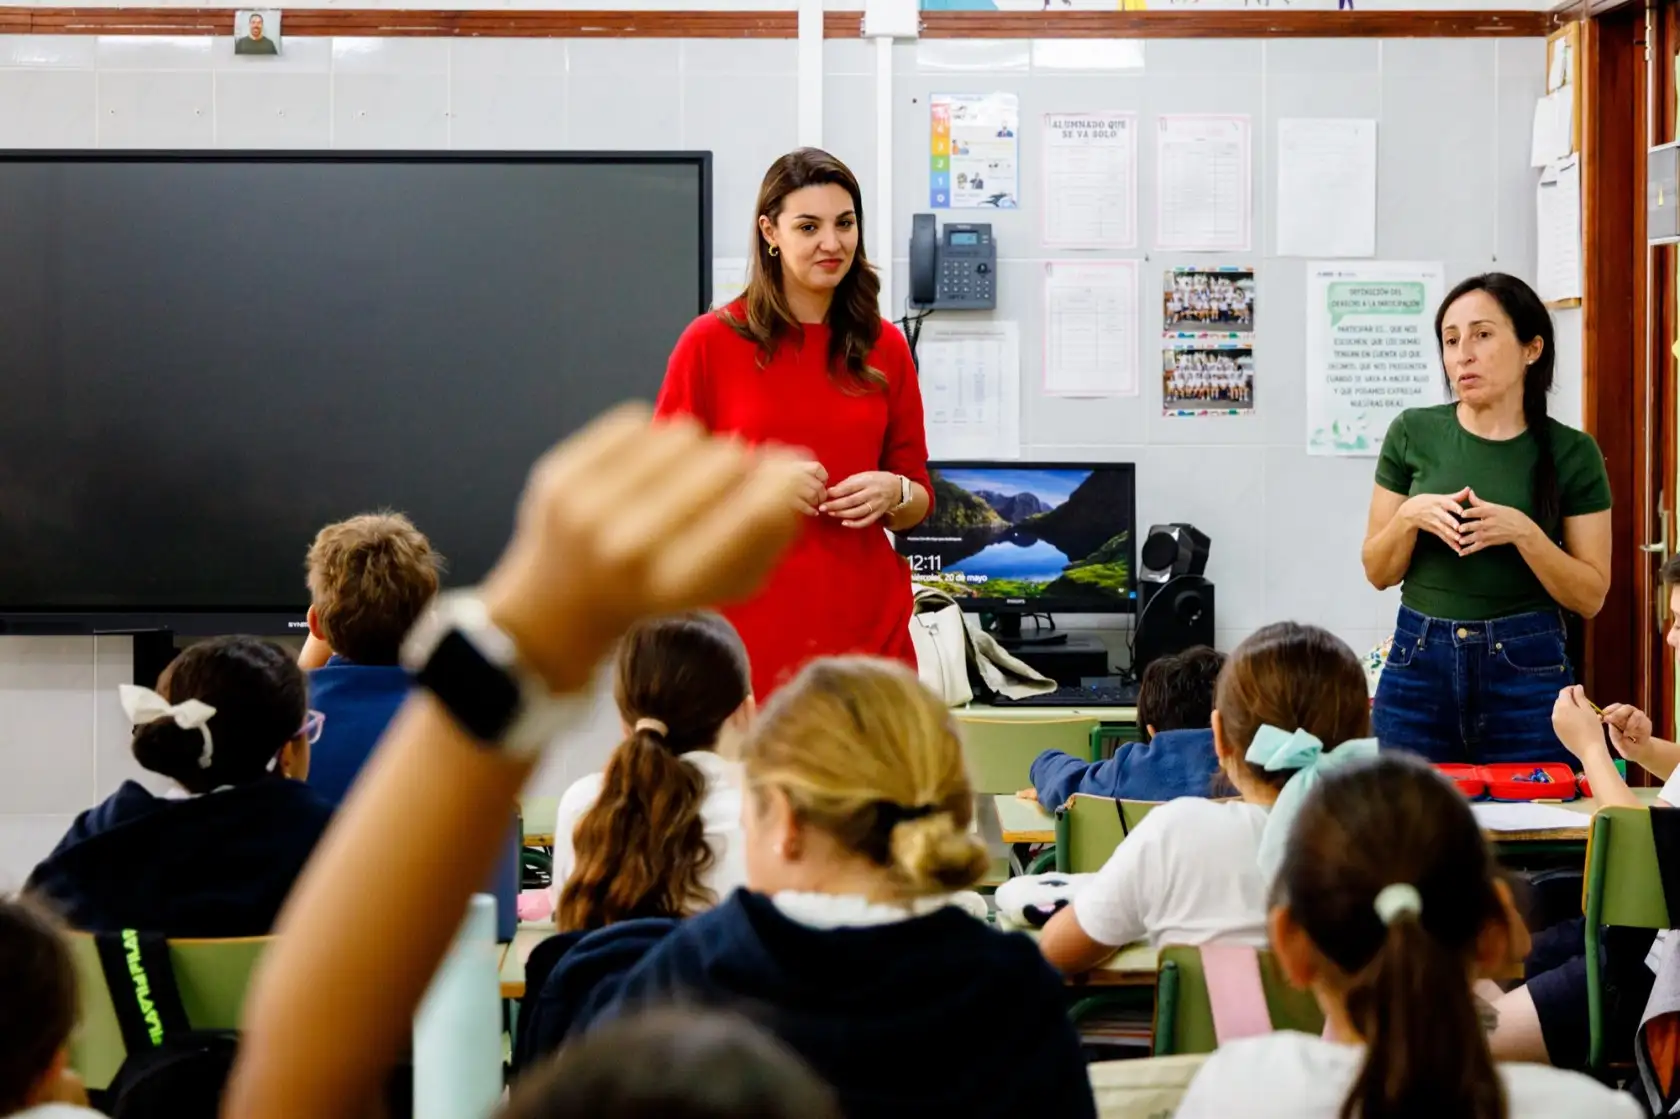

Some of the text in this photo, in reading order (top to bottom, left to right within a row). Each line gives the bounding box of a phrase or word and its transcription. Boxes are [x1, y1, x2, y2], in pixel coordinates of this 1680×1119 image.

[1052, 120, 1126, 129] ALUMNADO QUE
[1062, 130, 1117, 138] SE VA SOLO
[907, 555, 941, 571] 12:11
[944, 574, 954, 582] 20
[966, 574, 988, 583] mayo
